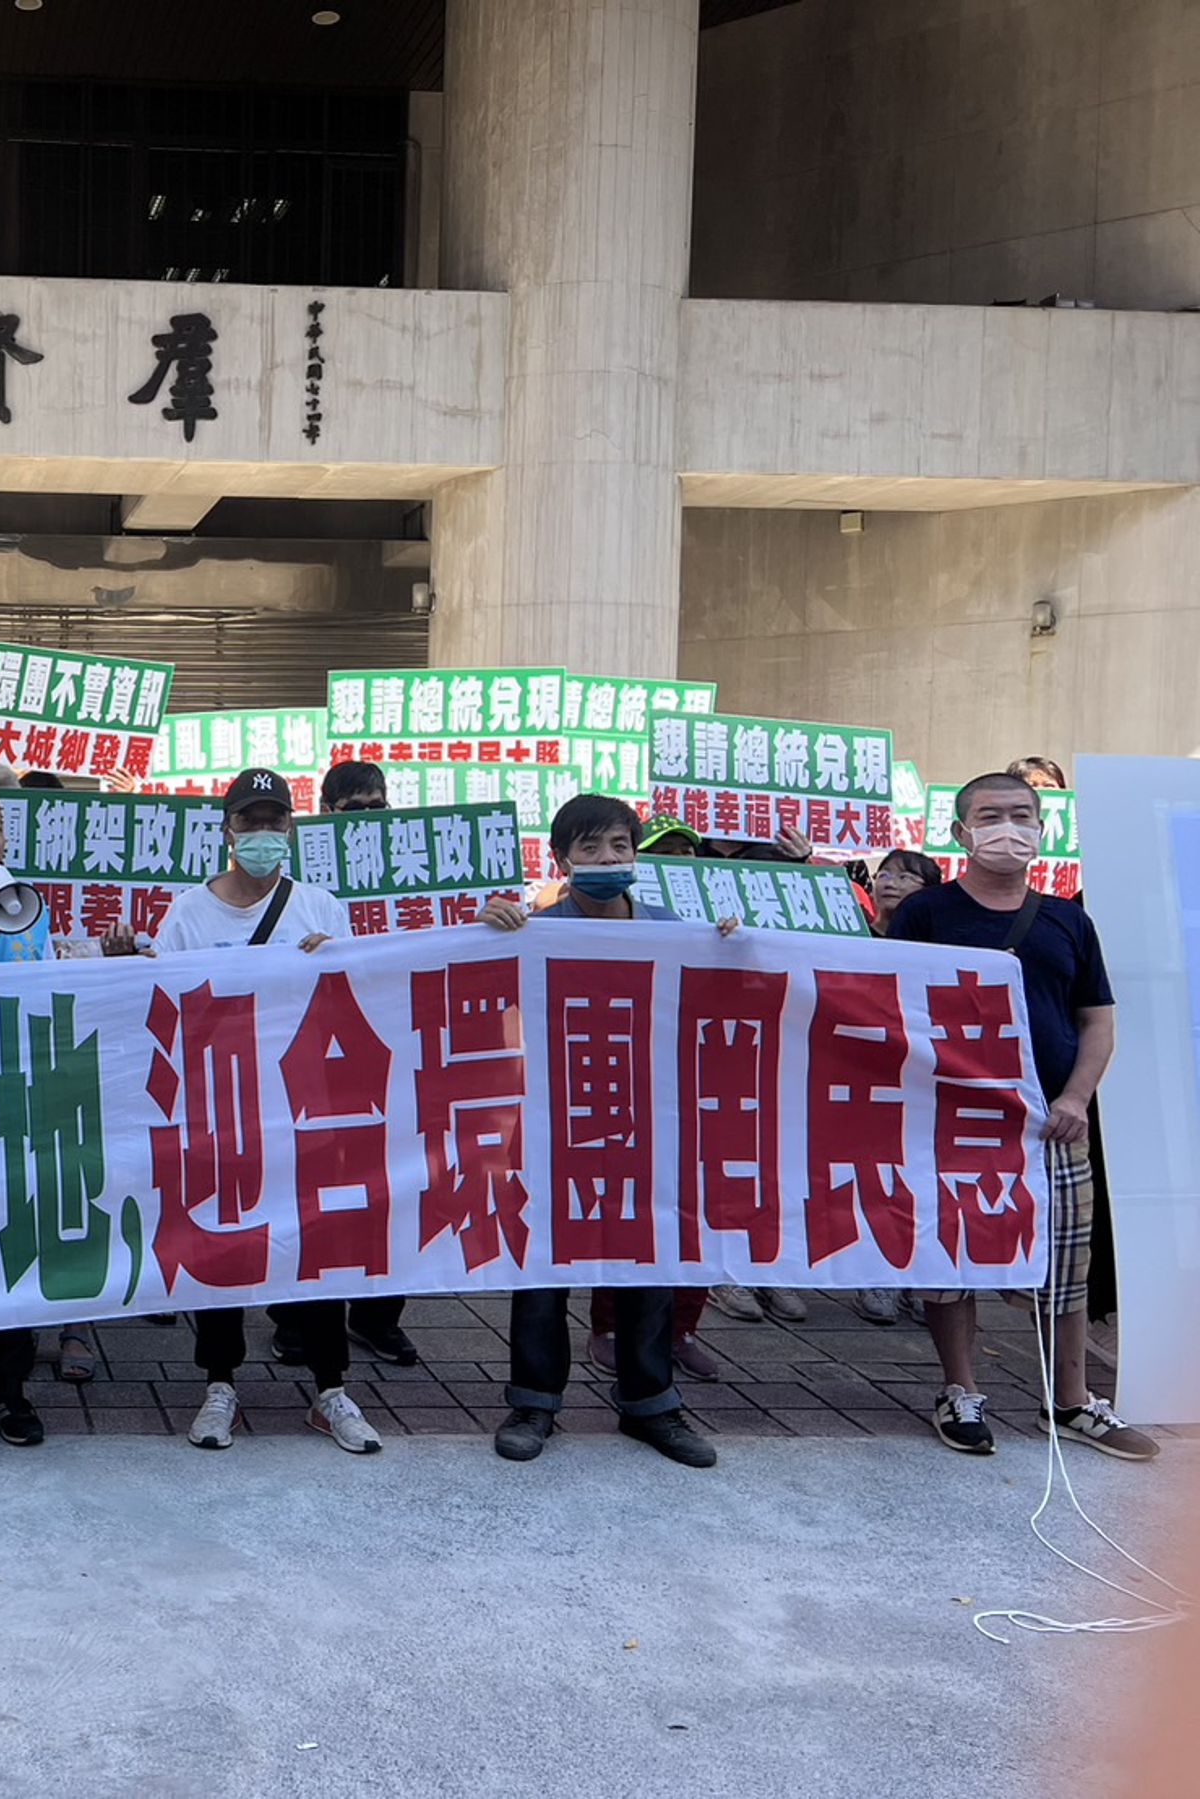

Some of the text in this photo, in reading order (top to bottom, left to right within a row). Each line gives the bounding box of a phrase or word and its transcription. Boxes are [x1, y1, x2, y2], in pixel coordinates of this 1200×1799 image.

[331, 674, 561, 734] 懇請總統兌現
[653, 717, 888, 796] 懇請總統兌現
[280, 810, 515, 893] 團綁架政府
